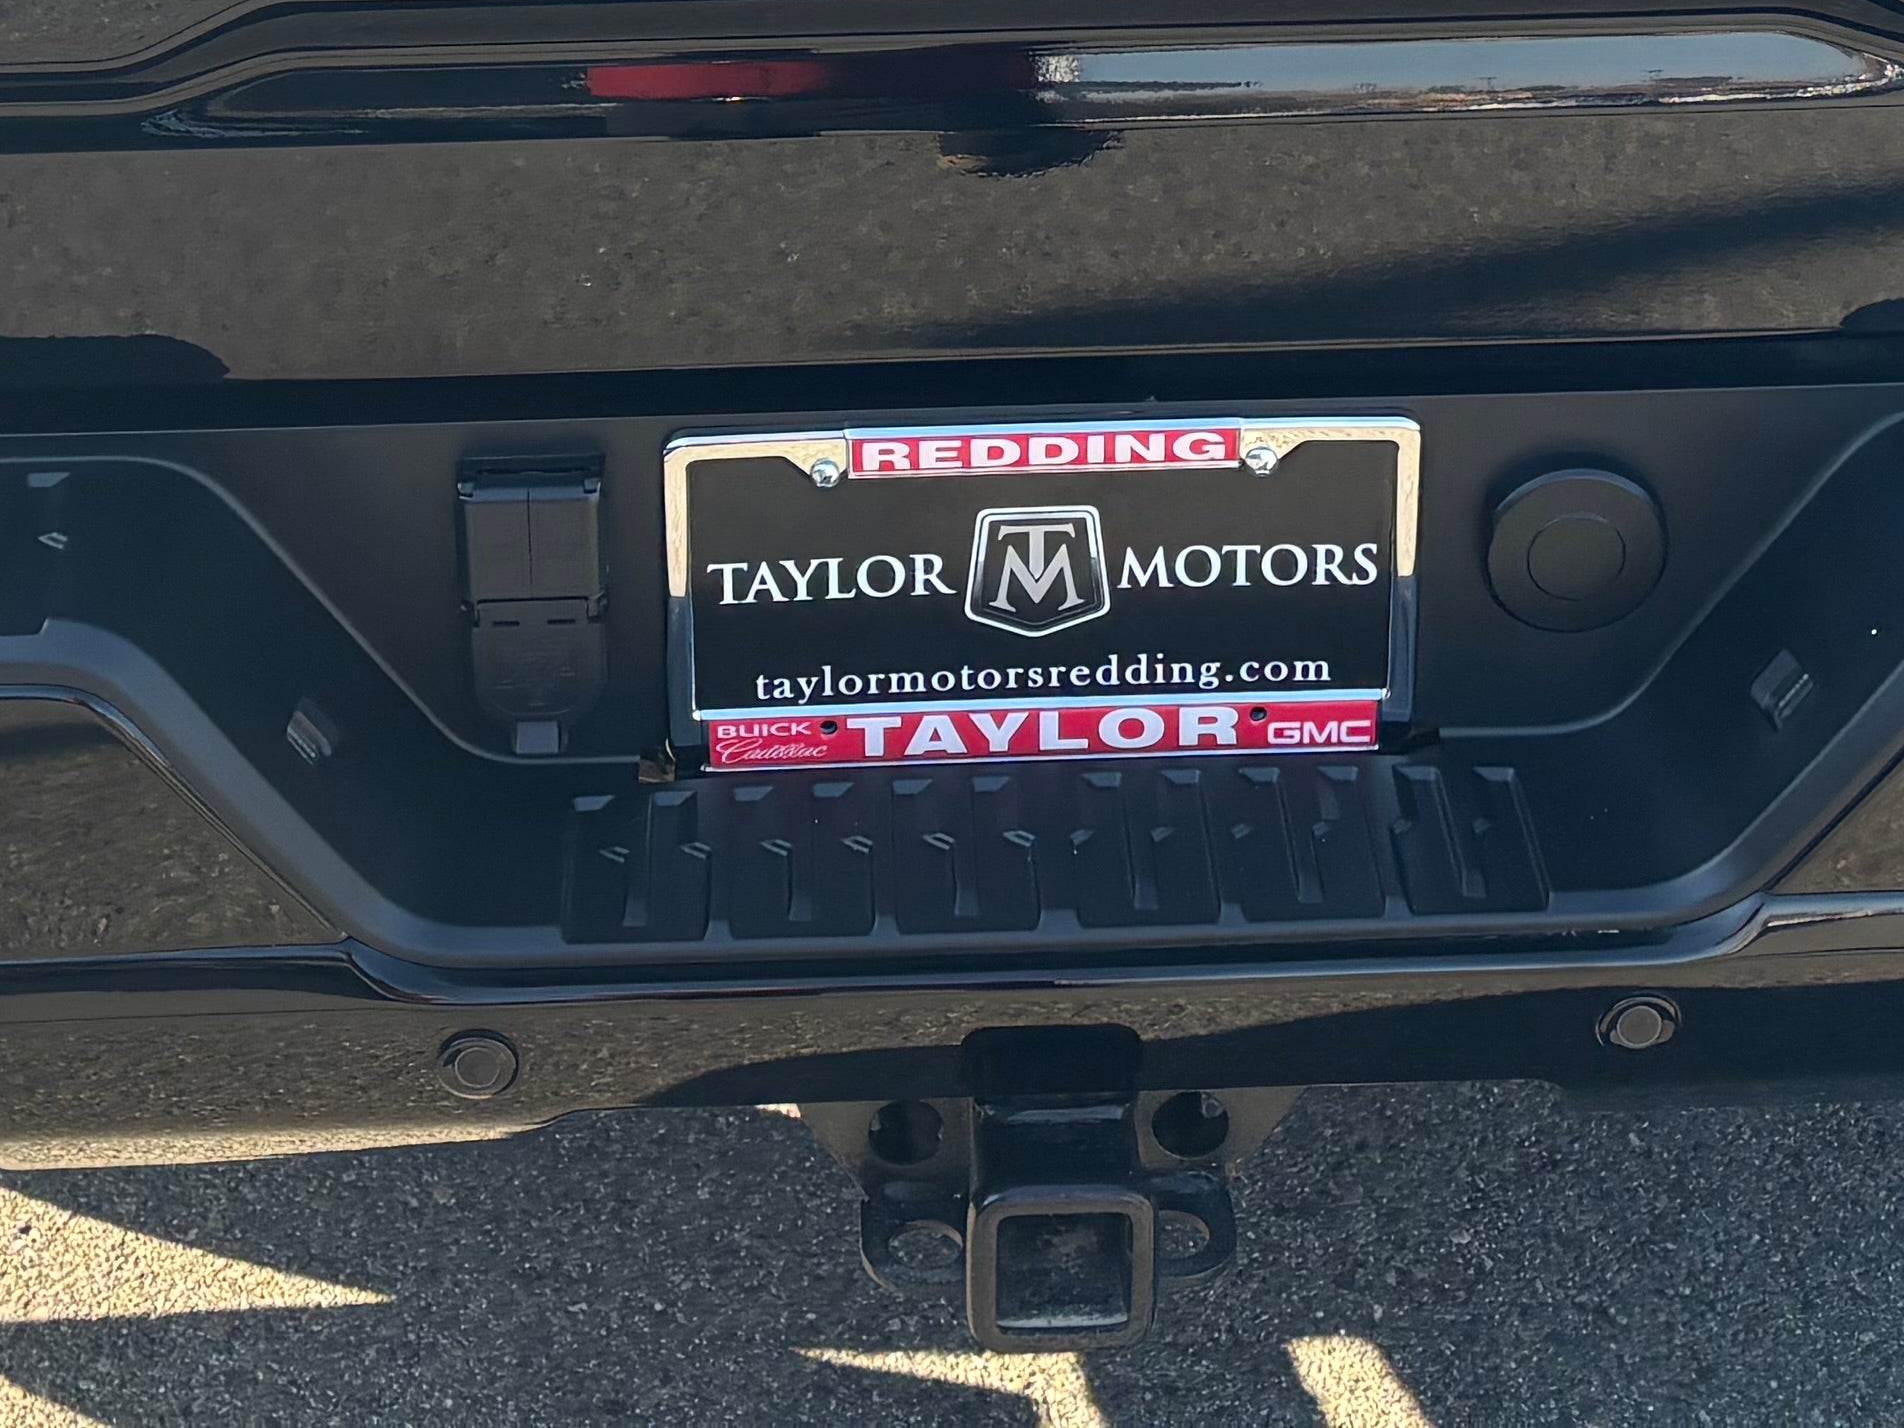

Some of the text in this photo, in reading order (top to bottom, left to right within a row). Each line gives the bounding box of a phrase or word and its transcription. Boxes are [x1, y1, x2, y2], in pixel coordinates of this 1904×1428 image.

[861, 431, 1226, 472] REDDING
[706, 553, 957, 605] TAYLOR
[1116, 542, 1378, 589] MOTORS
[755, 652, 1332, 705] taylormotorsredding.com
[717, 721, 813, 739] BUICK
[846, 705, 1240, 757] TAYLOR
[1266, 719, 1373, 745] GMC
[715, 738, 828, 764] Cadillac
